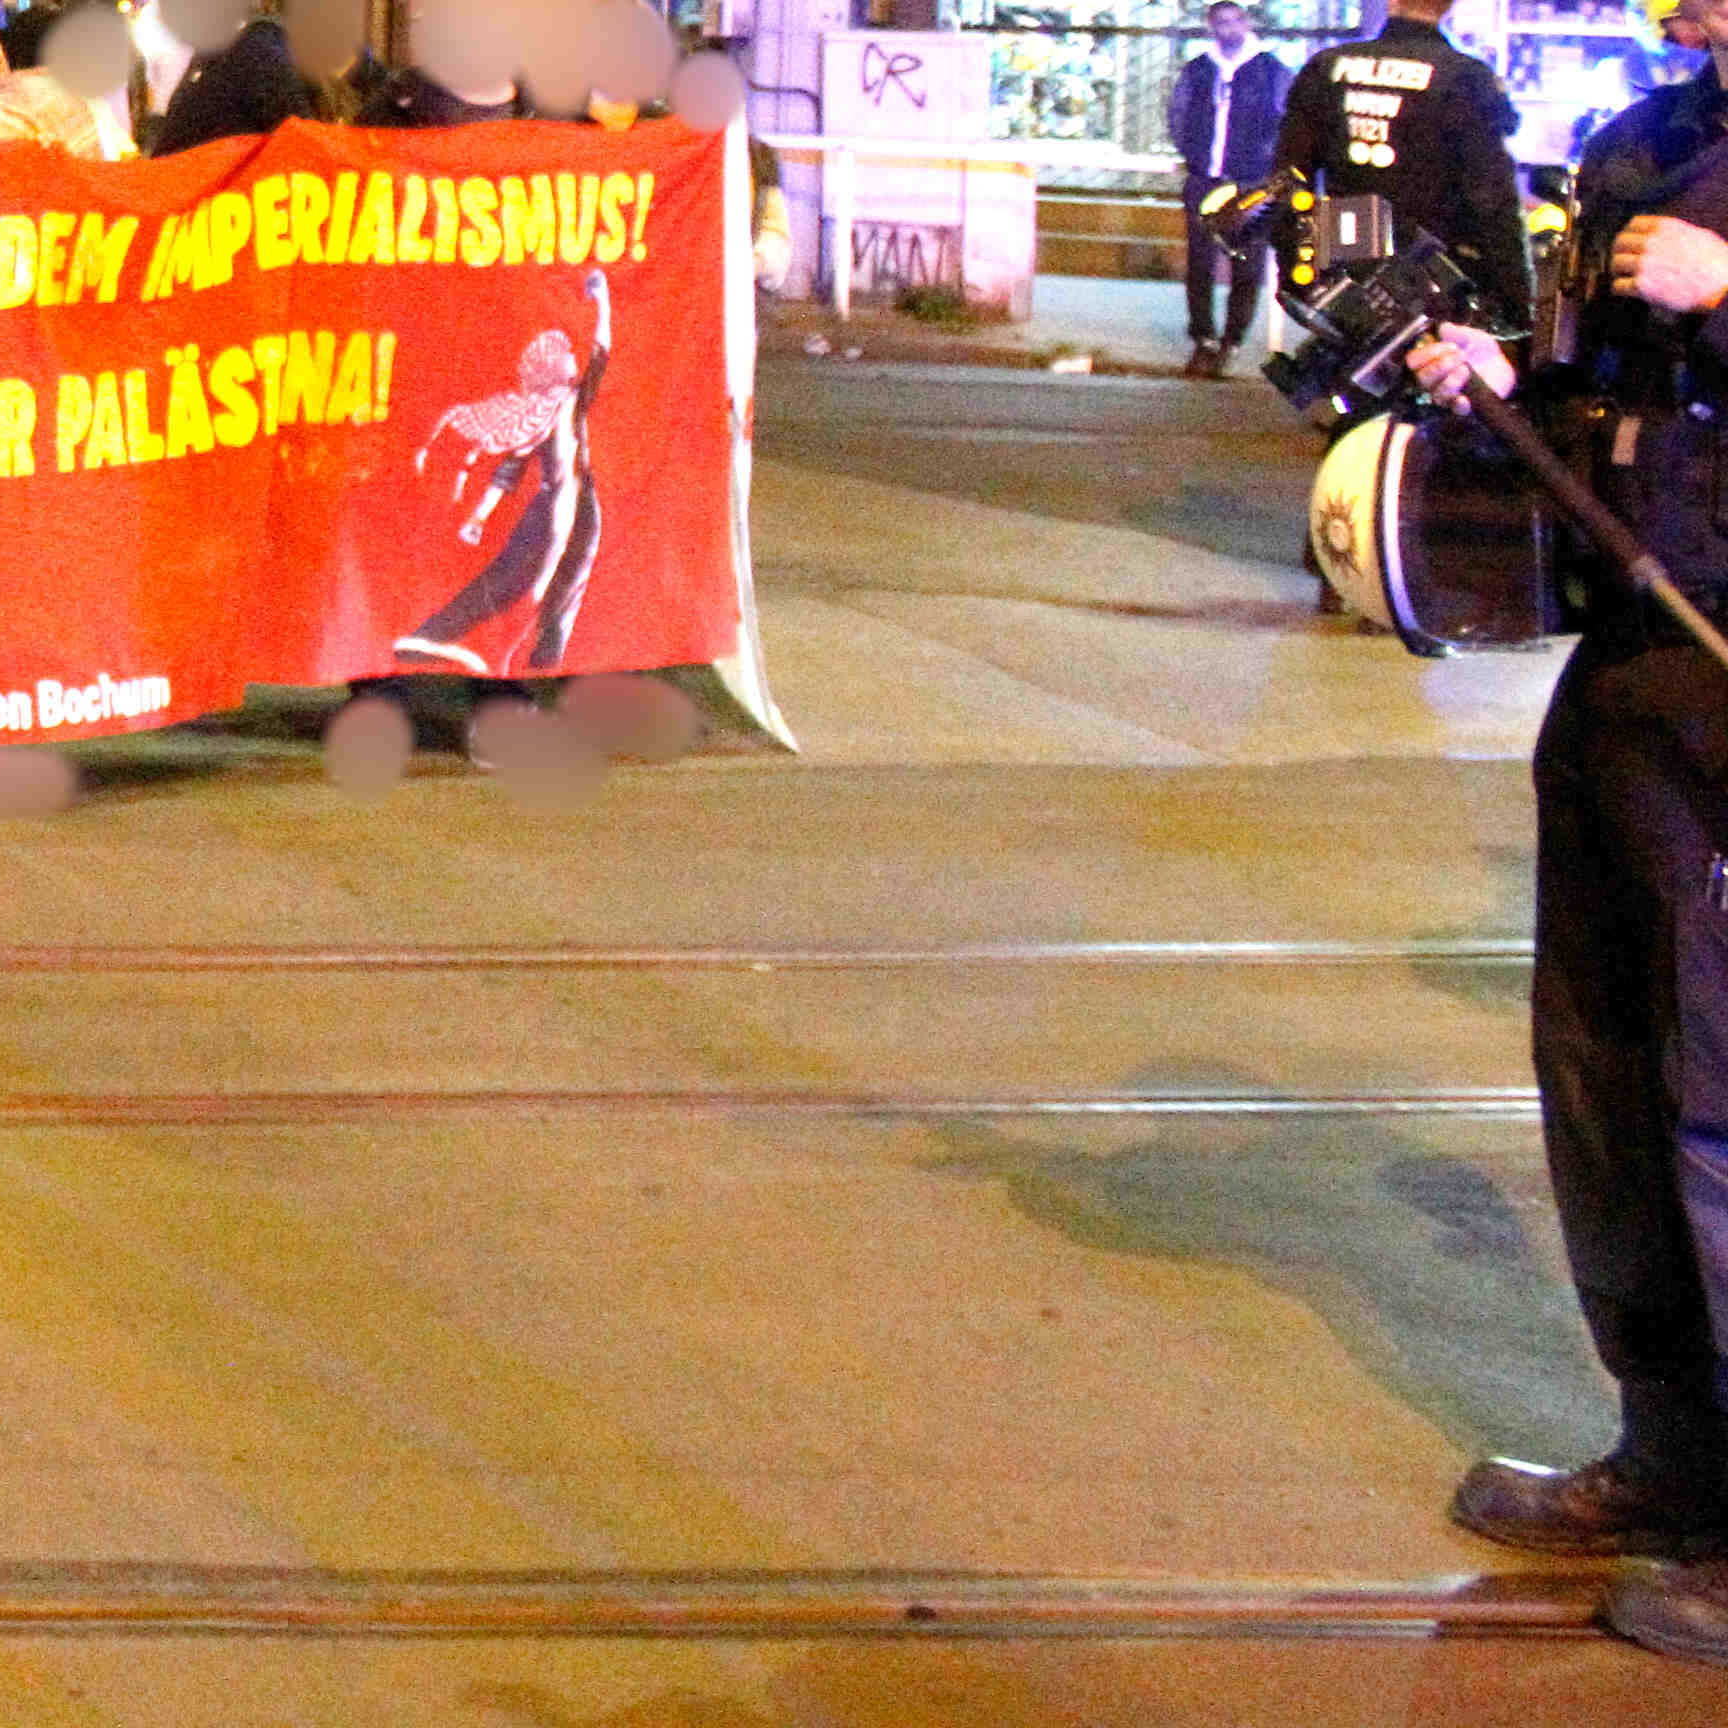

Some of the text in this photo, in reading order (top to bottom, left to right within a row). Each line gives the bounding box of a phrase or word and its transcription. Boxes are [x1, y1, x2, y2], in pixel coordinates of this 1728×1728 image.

[1332, 55, 1435, 91] POLIZEI
[140, 170, 654, 303] IMPERIALISMUS!
[36, 672, 172, 730] Bochum
